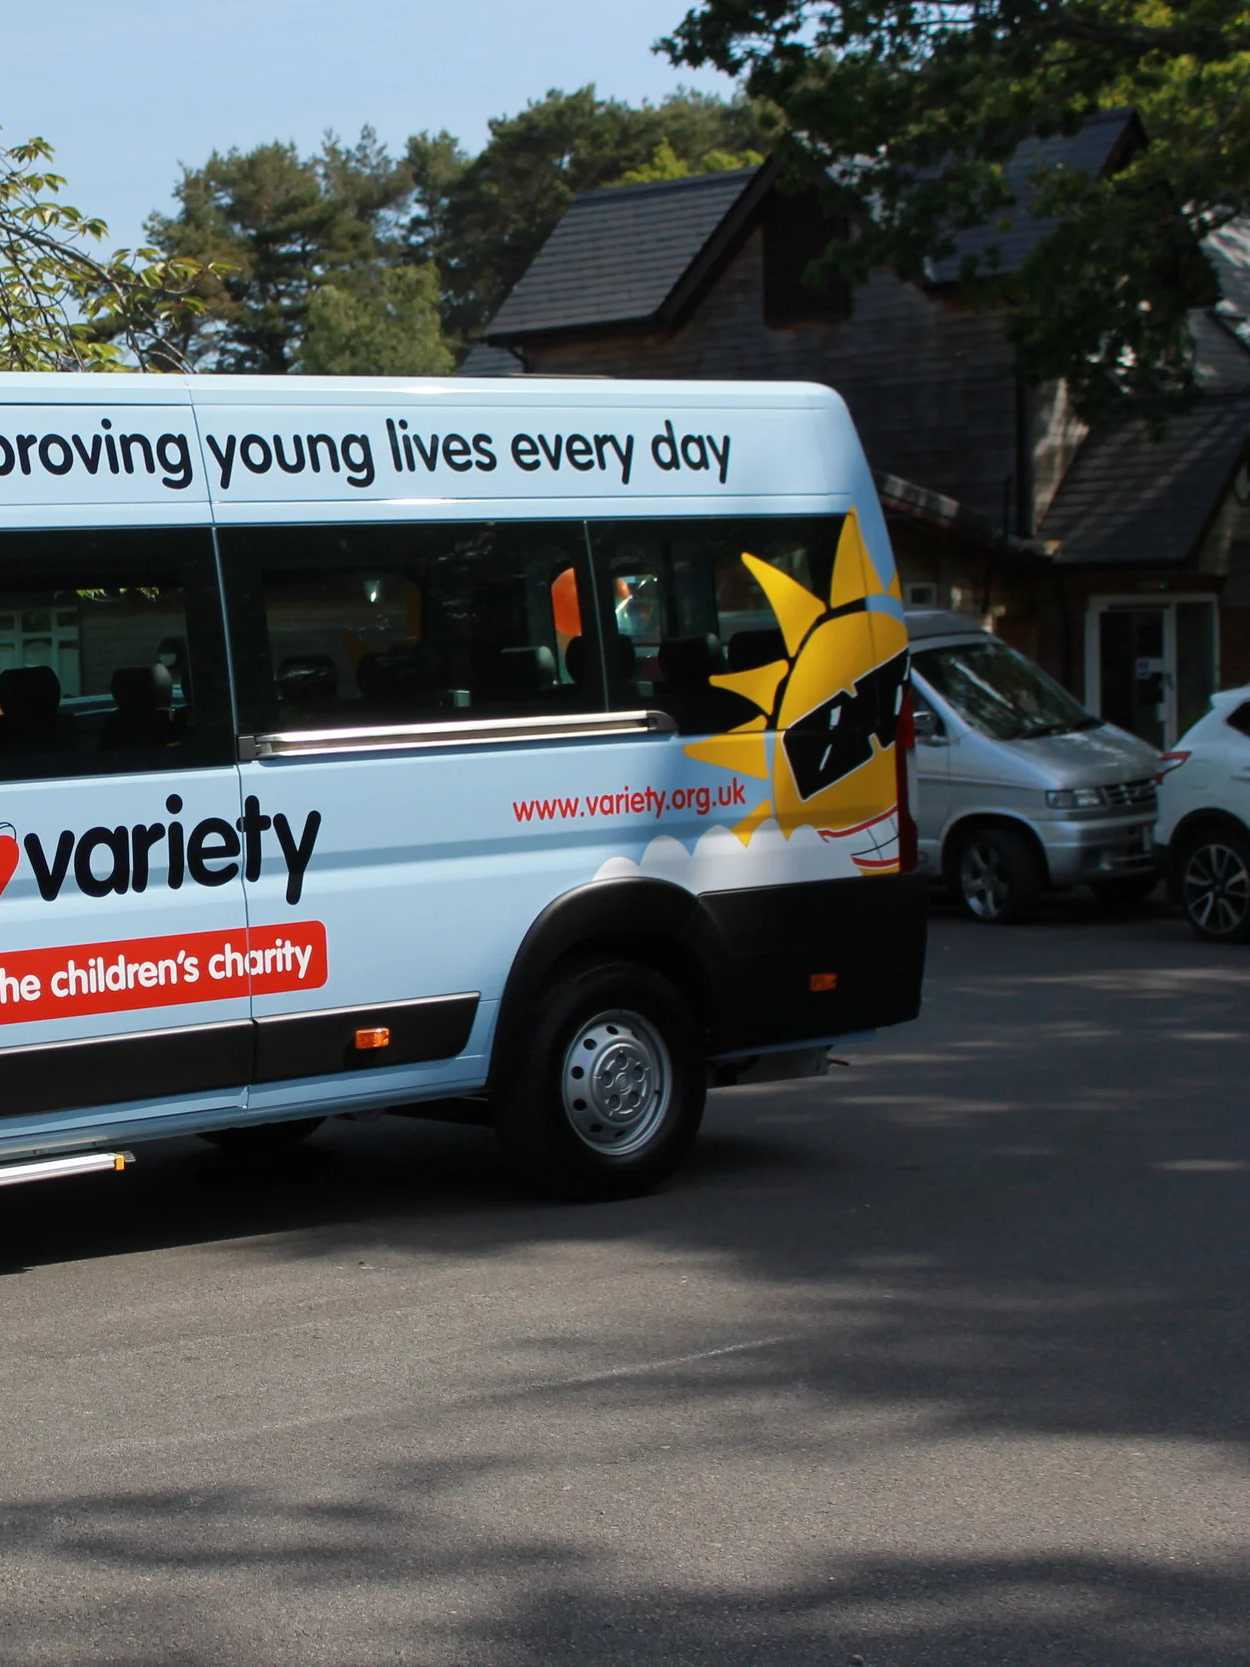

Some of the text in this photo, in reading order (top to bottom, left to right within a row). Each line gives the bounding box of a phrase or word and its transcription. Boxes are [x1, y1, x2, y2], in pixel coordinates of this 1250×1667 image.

[204, 433, 377, 489] young
[385, 418, 498, 473] lives
[510, 433, 635, 485] every
[651, 419, 731, 485] day
[512, 777, 746, 823] www.variety.org.uk
[23, 793, 322, 905] variety
[50, 950, 199, 998] children's
[208, 938, 313, 980] charity
